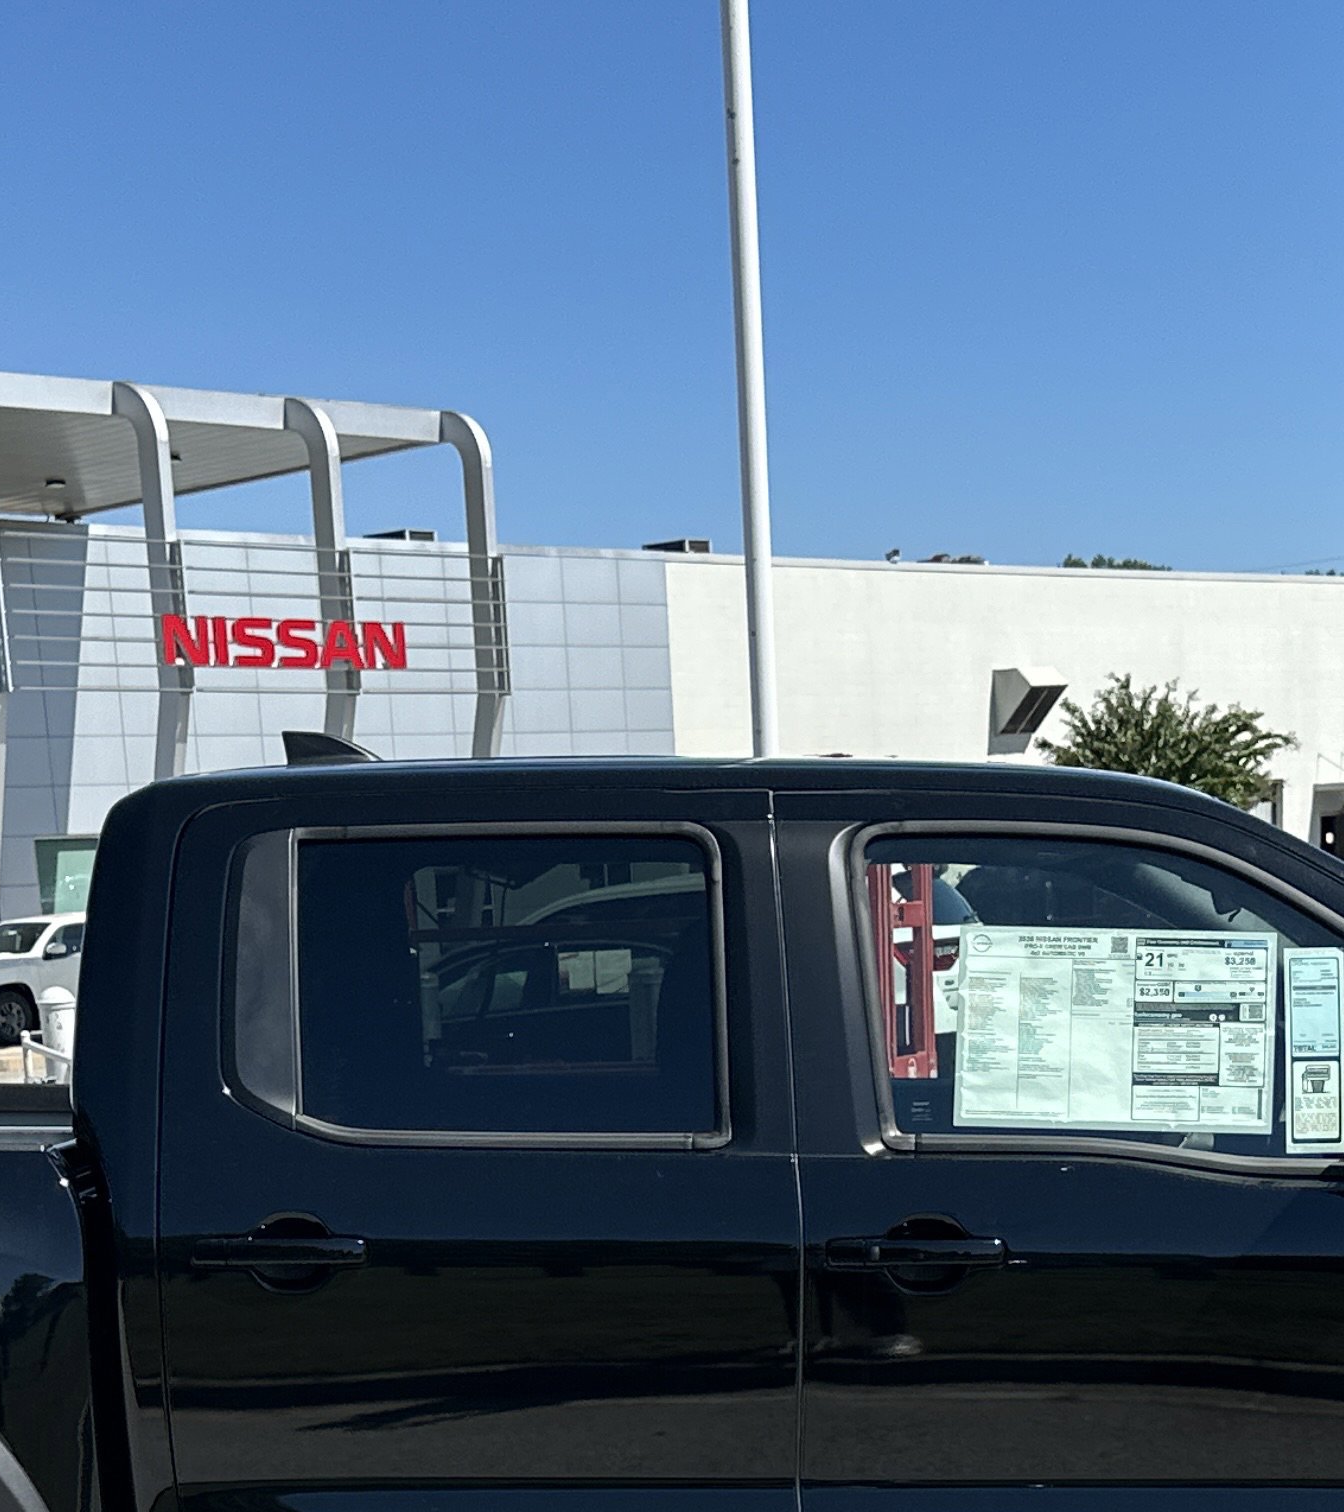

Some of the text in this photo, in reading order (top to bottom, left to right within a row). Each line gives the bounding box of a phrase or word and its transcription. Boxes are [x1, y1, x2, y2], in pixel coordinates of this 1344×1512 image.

[160, 613, 407, 670] NISSAN
[1144, 952, 1164, 967] 21
[1224, 957, 1256, 966] $3,250
[1139, 988, 1170, 997] $2,350
